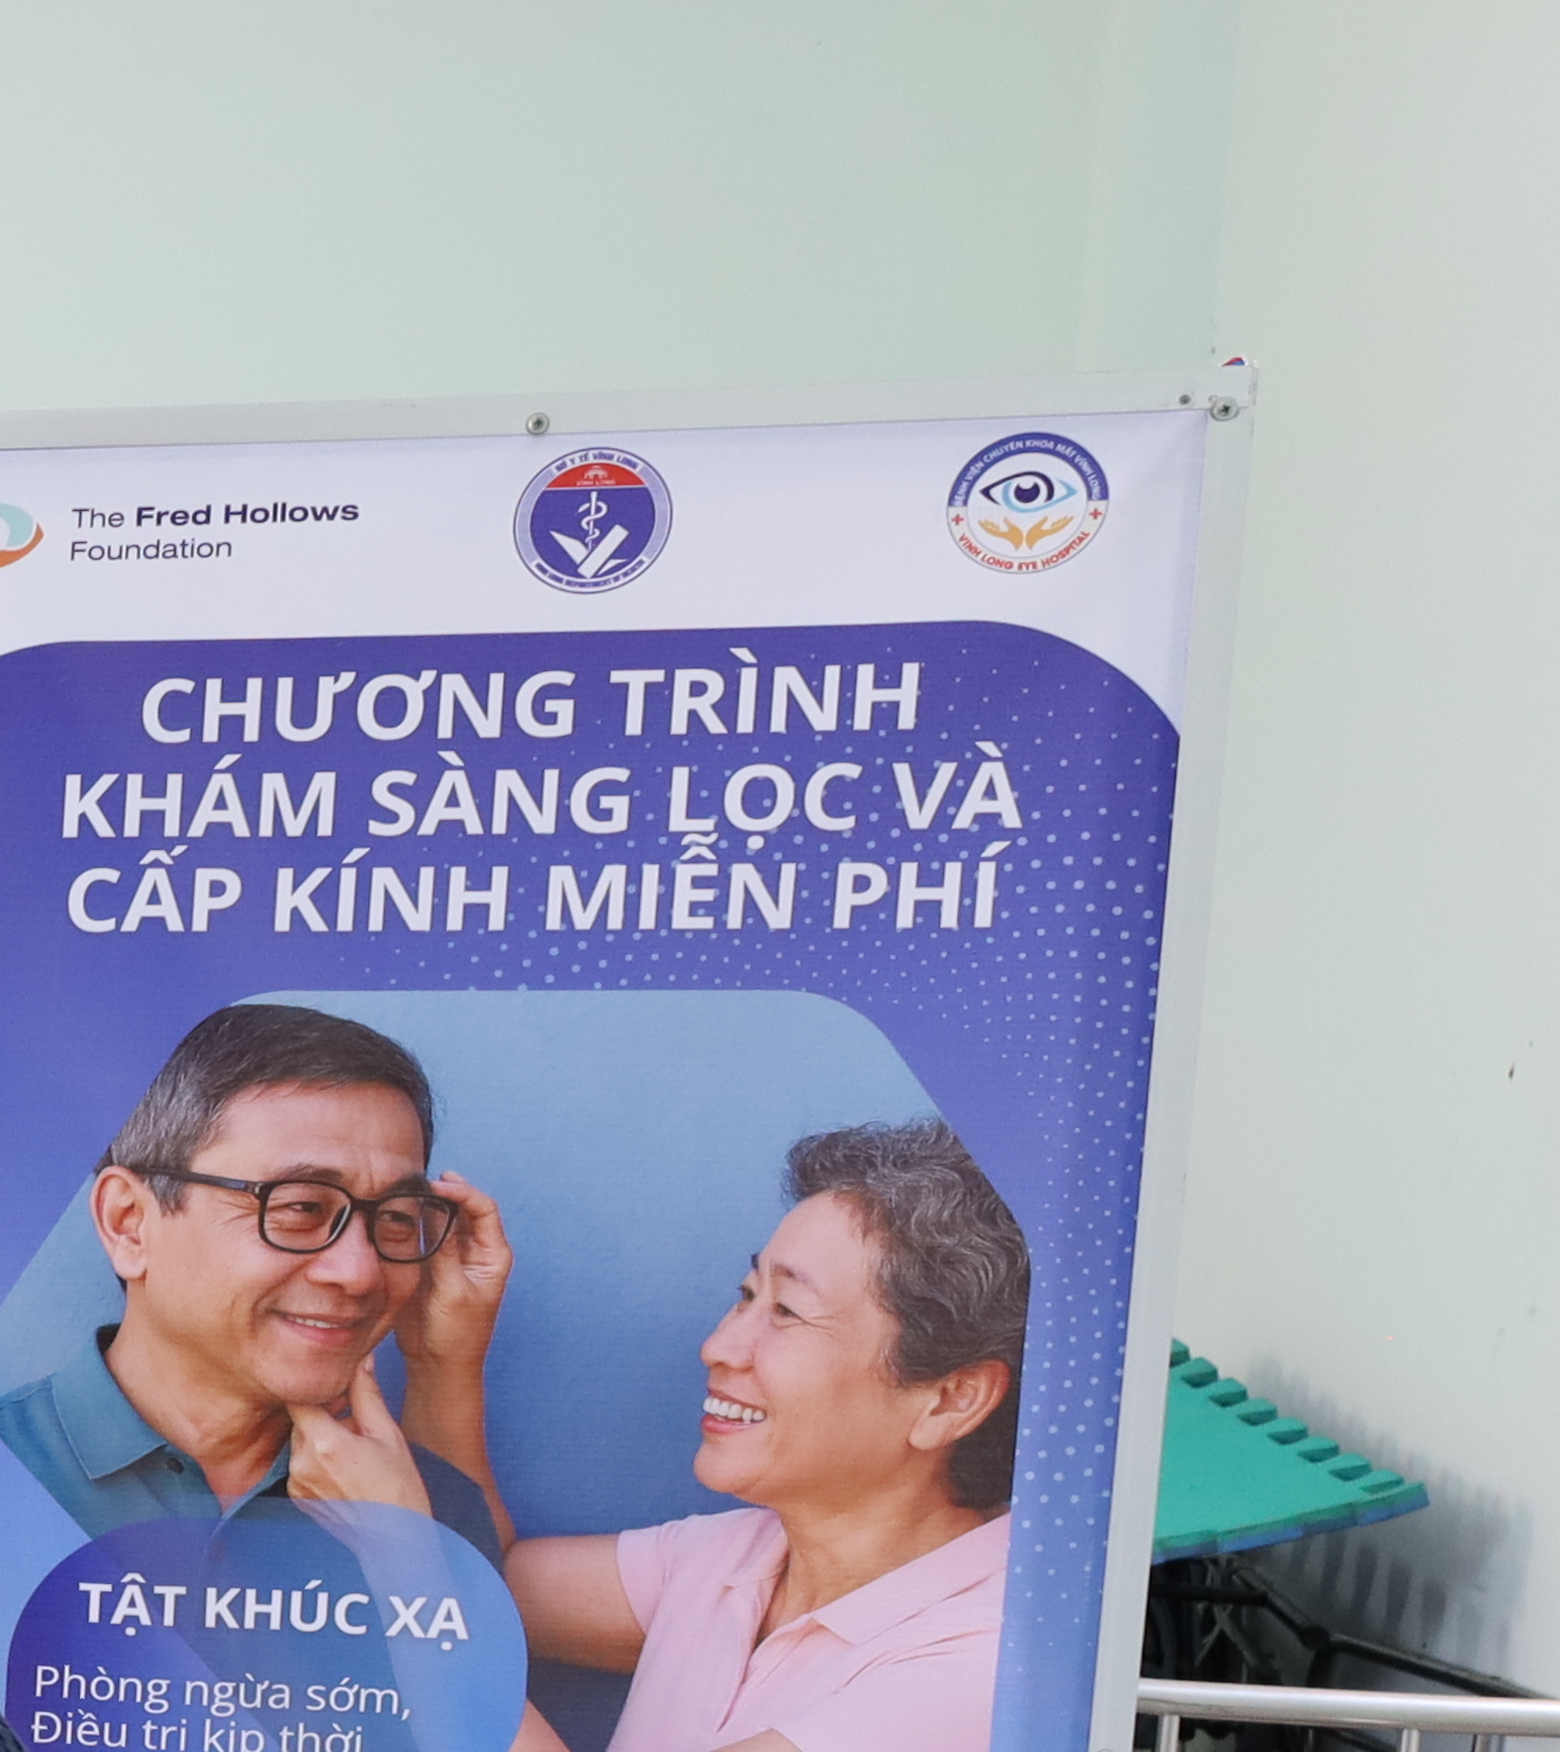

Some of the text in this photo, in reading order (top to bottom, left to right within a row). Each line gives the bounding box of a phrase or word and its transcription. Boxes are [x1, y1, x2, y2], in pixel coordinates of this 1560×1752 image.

[1025, 440, 1055, 449] KHOA
[1088, 473, 1103, 500] LONG
[72, 501, 359, 529] The Fred Hollows
[70, 538, 232, 561] Foundation
[958, 533, 982, 557] VINH
[981, 553, 1014, 570] LONG
[1041, 531, 1090, 568] HOSPITAL
[140, 648, 922, 745] CHƯƠNG TRÌNH
[61, 742, 1023, 851] KHÁM SÀNG LỌC VÀ
[65, 830, 1011, 934] CẤP KÍNH MIỄN PHÍ
[78, 1572, 470, 1651] TẬT KHÚC XẠ
[34, 1664, 412, 1722] Phòng ngừa sớm,
[31, 1708, 127, 1748] Điều
